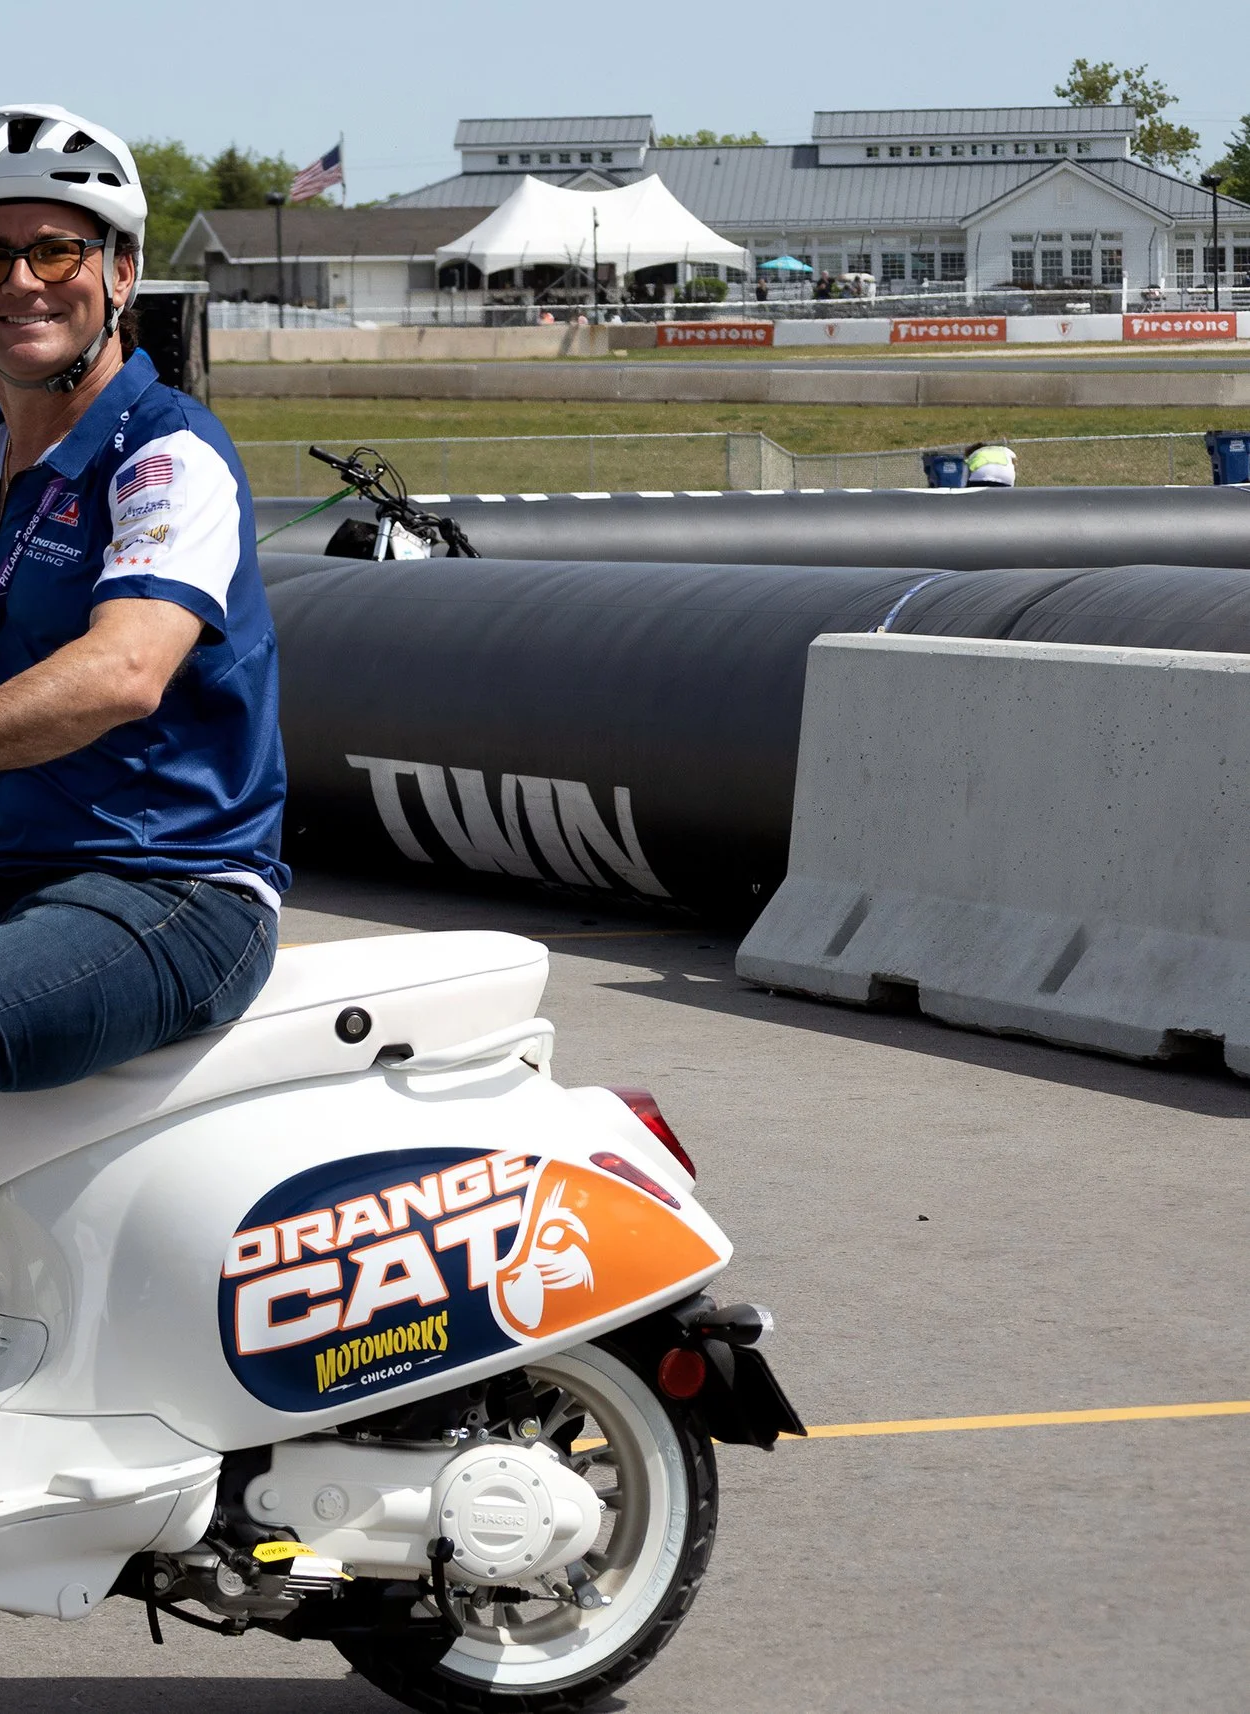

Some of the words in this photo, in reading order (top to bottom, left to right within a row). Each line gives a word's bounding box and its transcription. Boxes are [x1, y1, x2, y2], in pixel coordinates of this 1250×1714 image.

[664, 327, 767, 341] Firestone
[897, 322, 1000, 338] Firestone
[1130, 318, 1230, 335] Firestone
[0, 542, 24, 586] PITLANE
[22, 514, 40, 541] 2026
[23, 548, 65, 567] ACING
[345, 754, 673, 897] TWIN
[222, 1150, 537, 1278] ORANGE
[235, 1195, 524, 1356] CAT
[314, 1311, 449, 1394] MOTOWORKS
[360, 1362, 413, 1386] CHICAGO
[471, 1510, 526, 1527] PIAGGIO
